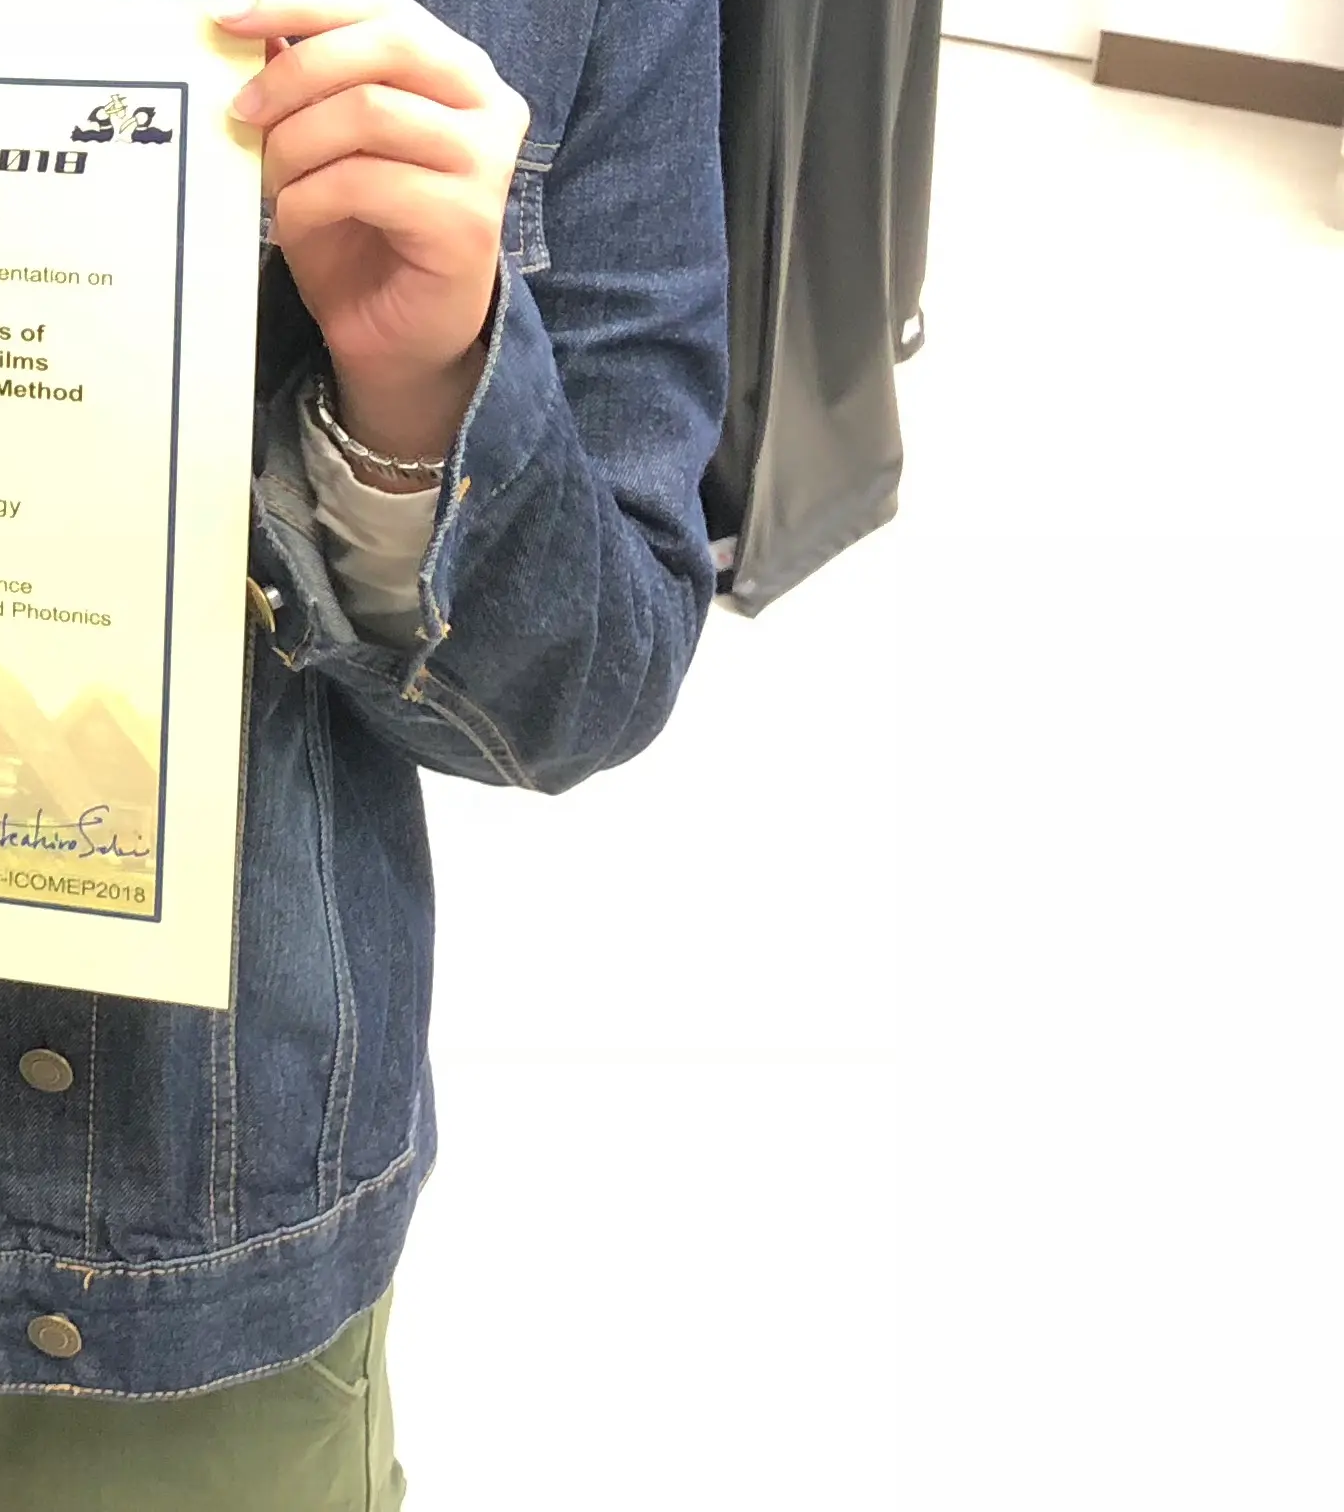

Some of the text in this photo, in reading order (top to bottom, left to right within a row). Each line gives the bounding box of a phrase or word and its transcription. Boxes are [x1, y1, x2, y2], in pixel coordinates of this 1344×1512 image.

[88, 273, 112, 285] on
[20, 325, 45, 342] of
[13, 602, 111, 626] Photonics
